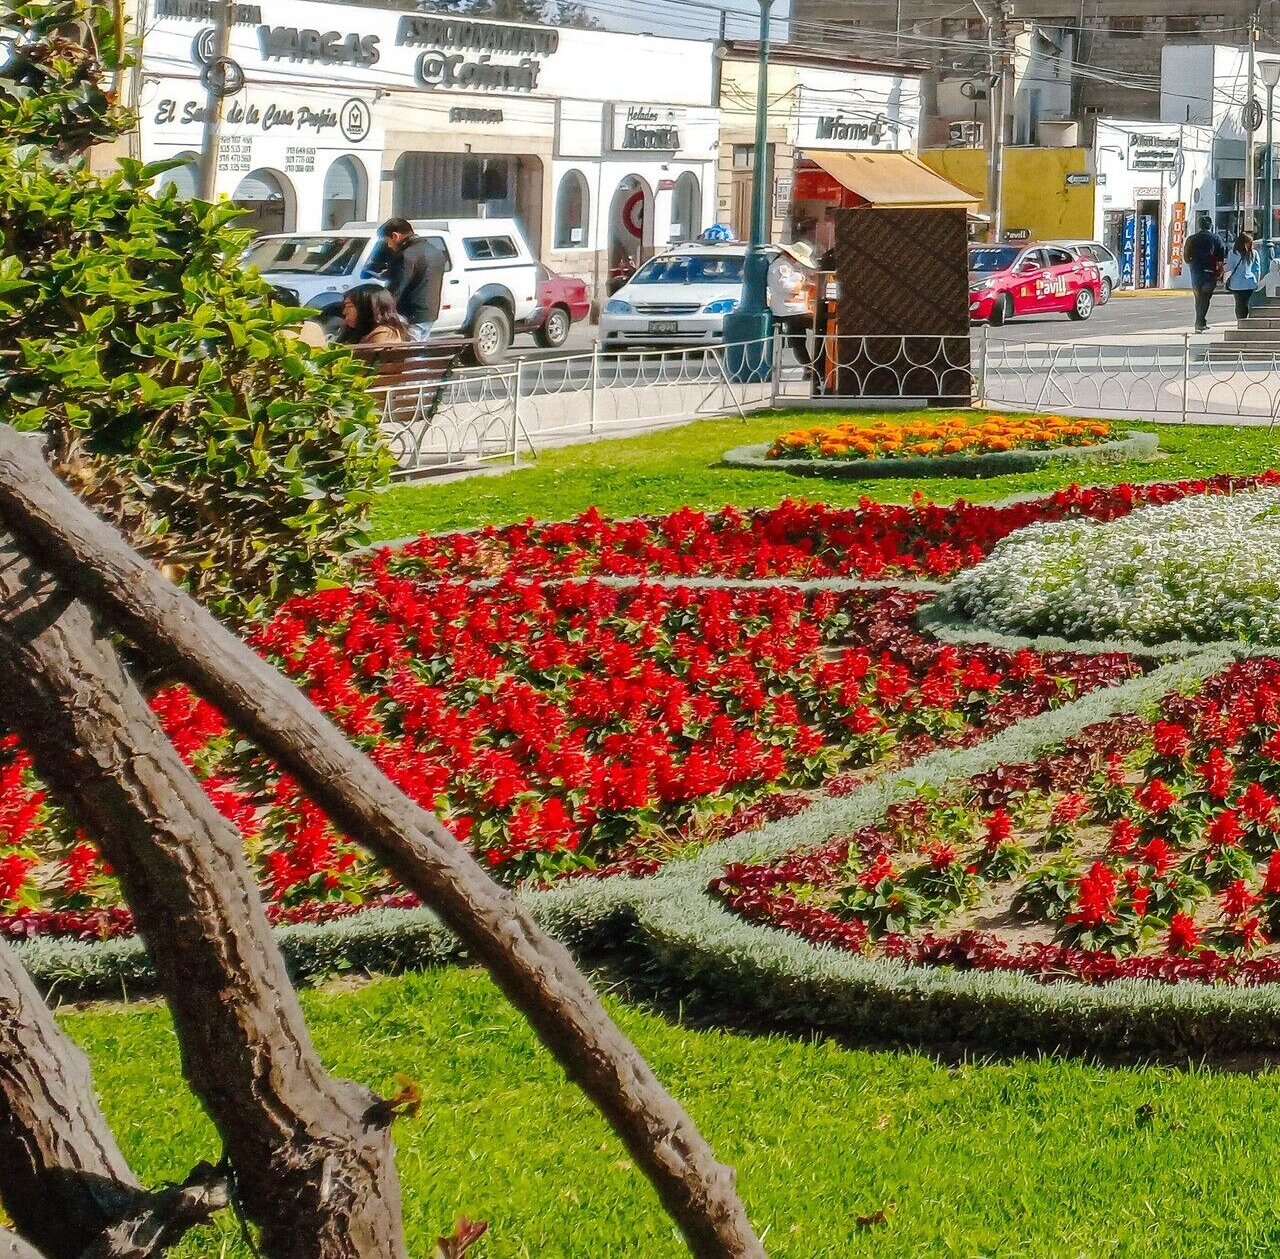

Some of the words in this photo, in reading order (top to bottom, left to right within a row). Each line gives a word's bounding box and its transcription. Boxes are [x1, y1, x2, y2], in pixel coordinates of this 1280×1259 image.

[257, 25, 380, 68] VARGAS
[154, 99, 176, 124] El
[227, 100, 245, 125] de
[246, 104, 260, 125] la
[262, 104, 295, 131] Casa
[297, 106, 338, 134] Propia
[627, 106, 658, 122] Helados
[816, 115, 868, 140] Mifarma
[1172, 209, 1182, 268] TOURS
